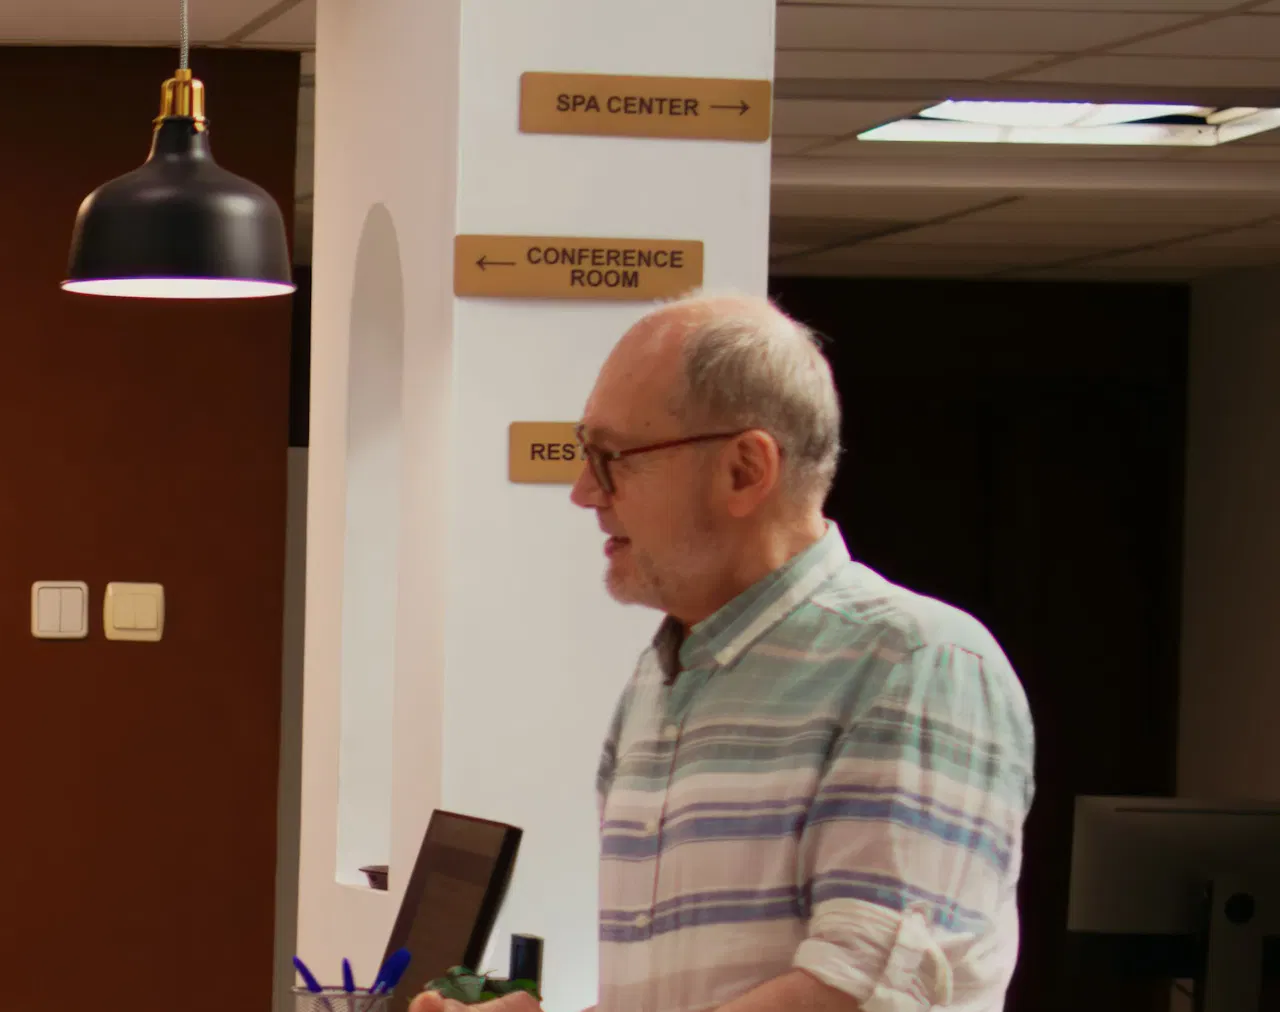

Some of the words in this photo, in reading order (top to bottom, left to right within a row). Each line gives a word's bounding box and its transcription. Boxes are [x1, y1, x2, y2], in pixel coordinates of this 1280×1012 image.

[556, 94, 600, 112] SPA
[607, 96, 699, 116] CENTER
[527, 247, 684, 268] CONFERENCE
[570, 269, 639, 288] ROOM
[530, 443, 585, 461] RES
